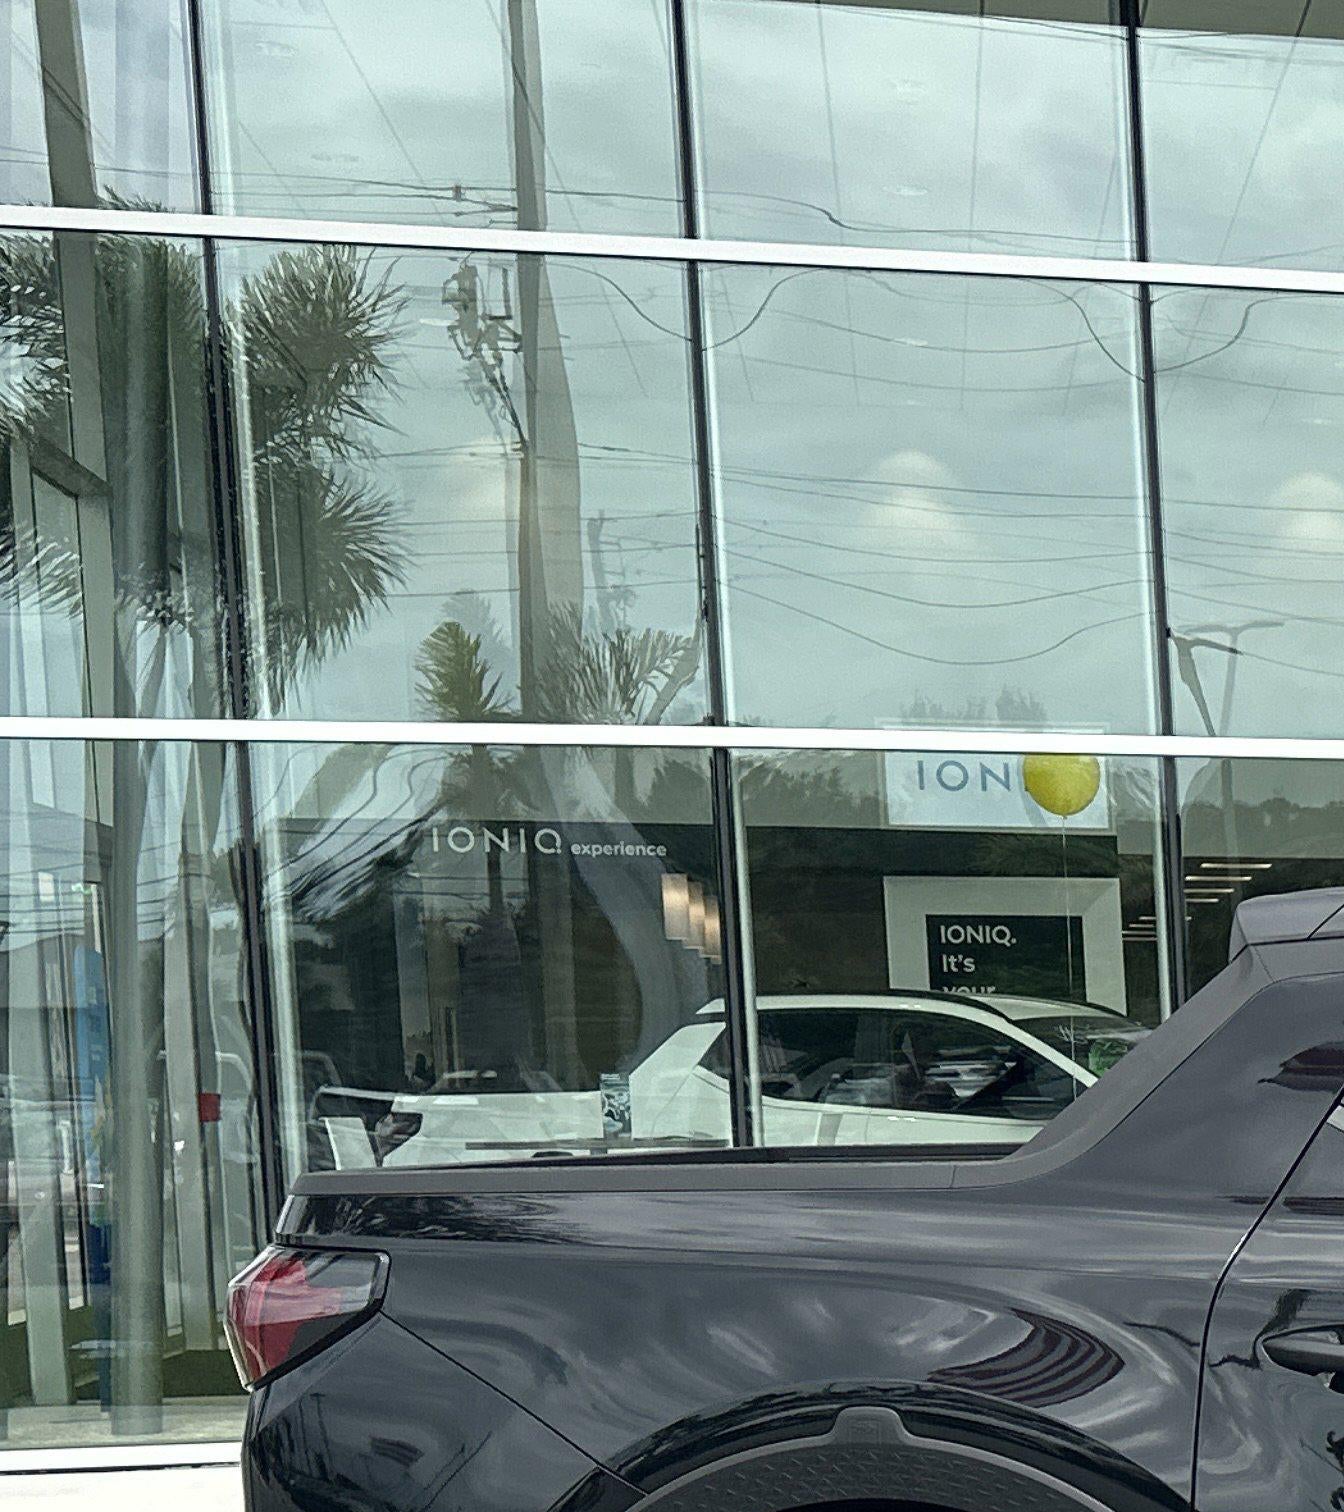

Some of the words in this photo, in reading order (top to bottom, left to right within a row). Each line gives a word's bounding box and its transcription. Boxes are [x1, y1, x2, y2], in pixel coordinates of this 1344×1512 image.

[916, 760, 1029, 792] ION
[432, 827, 562, 854] IONIQ
[570, 841, 667, 858] experience
[940, 925, 1017, 947] IONIQ.
